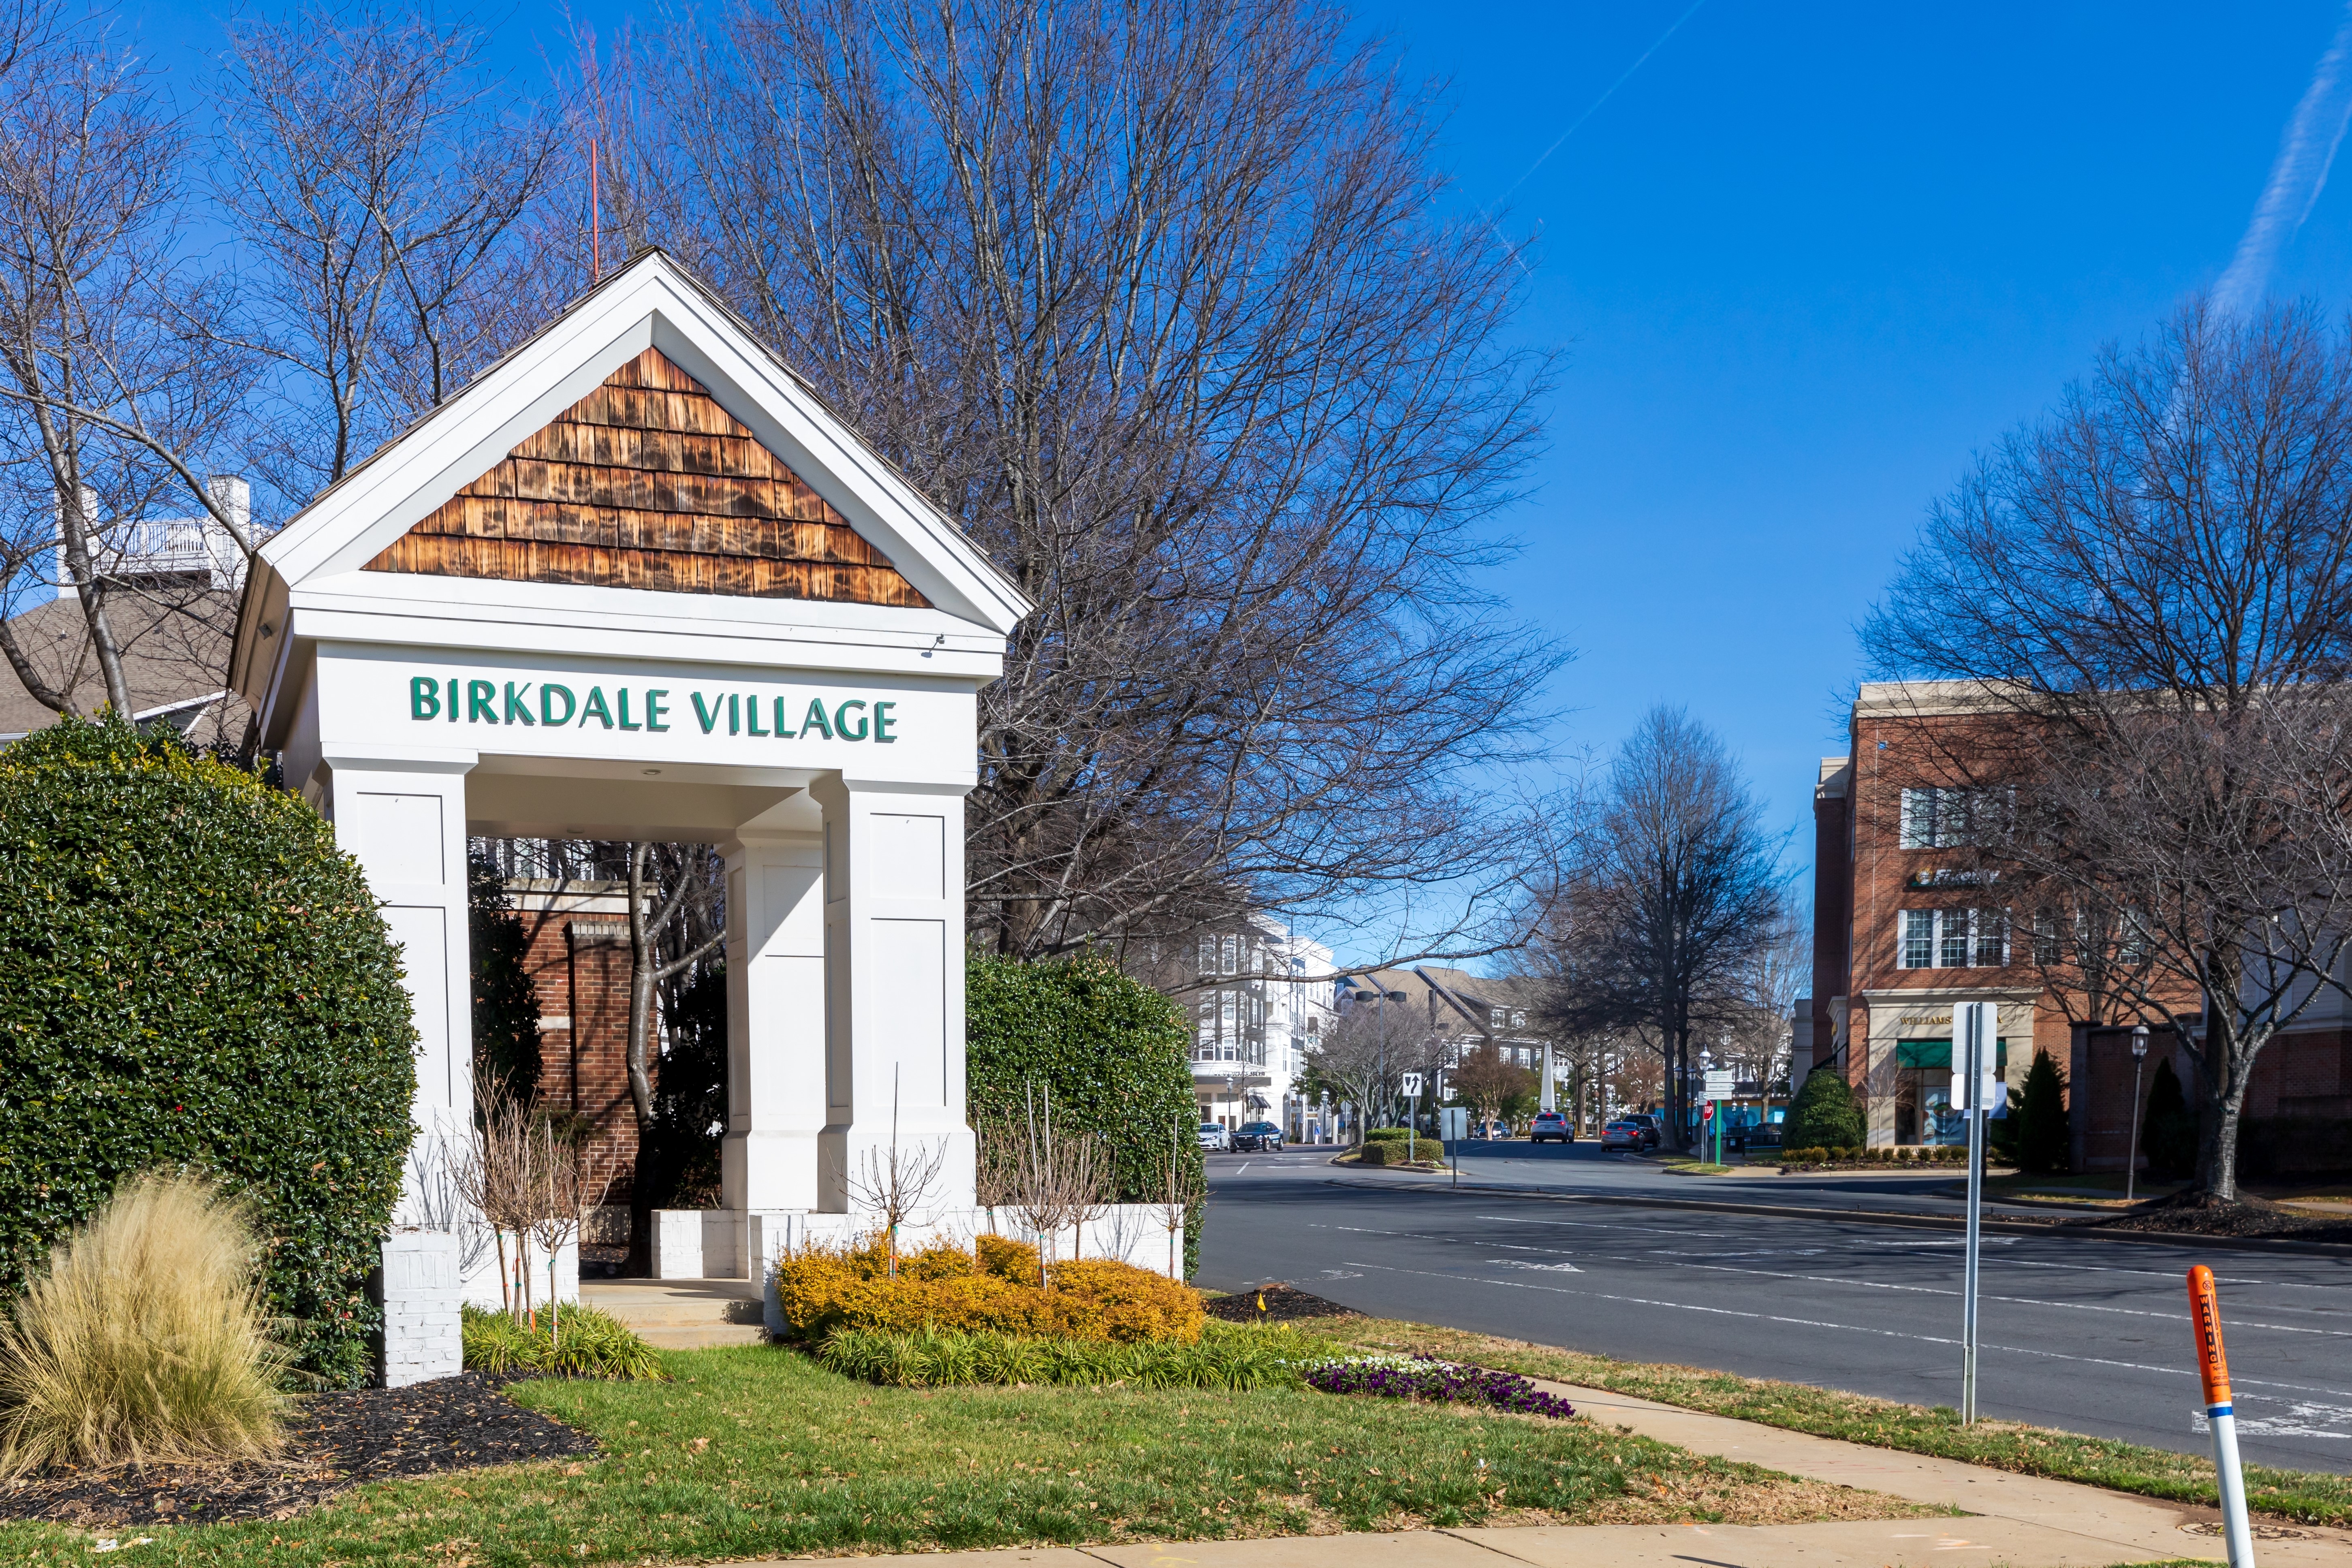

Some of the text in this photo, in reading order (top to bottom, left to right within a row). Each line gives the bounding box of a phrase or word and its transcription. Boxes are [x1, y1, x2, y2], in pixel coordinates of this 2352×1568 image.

[412, 677, 897, 740] BIRKDALE VILLAGE
[1900, 1017, 1952, 1025] WILLIAMS
[2200, 1296, 2217, 1362] WARNING
